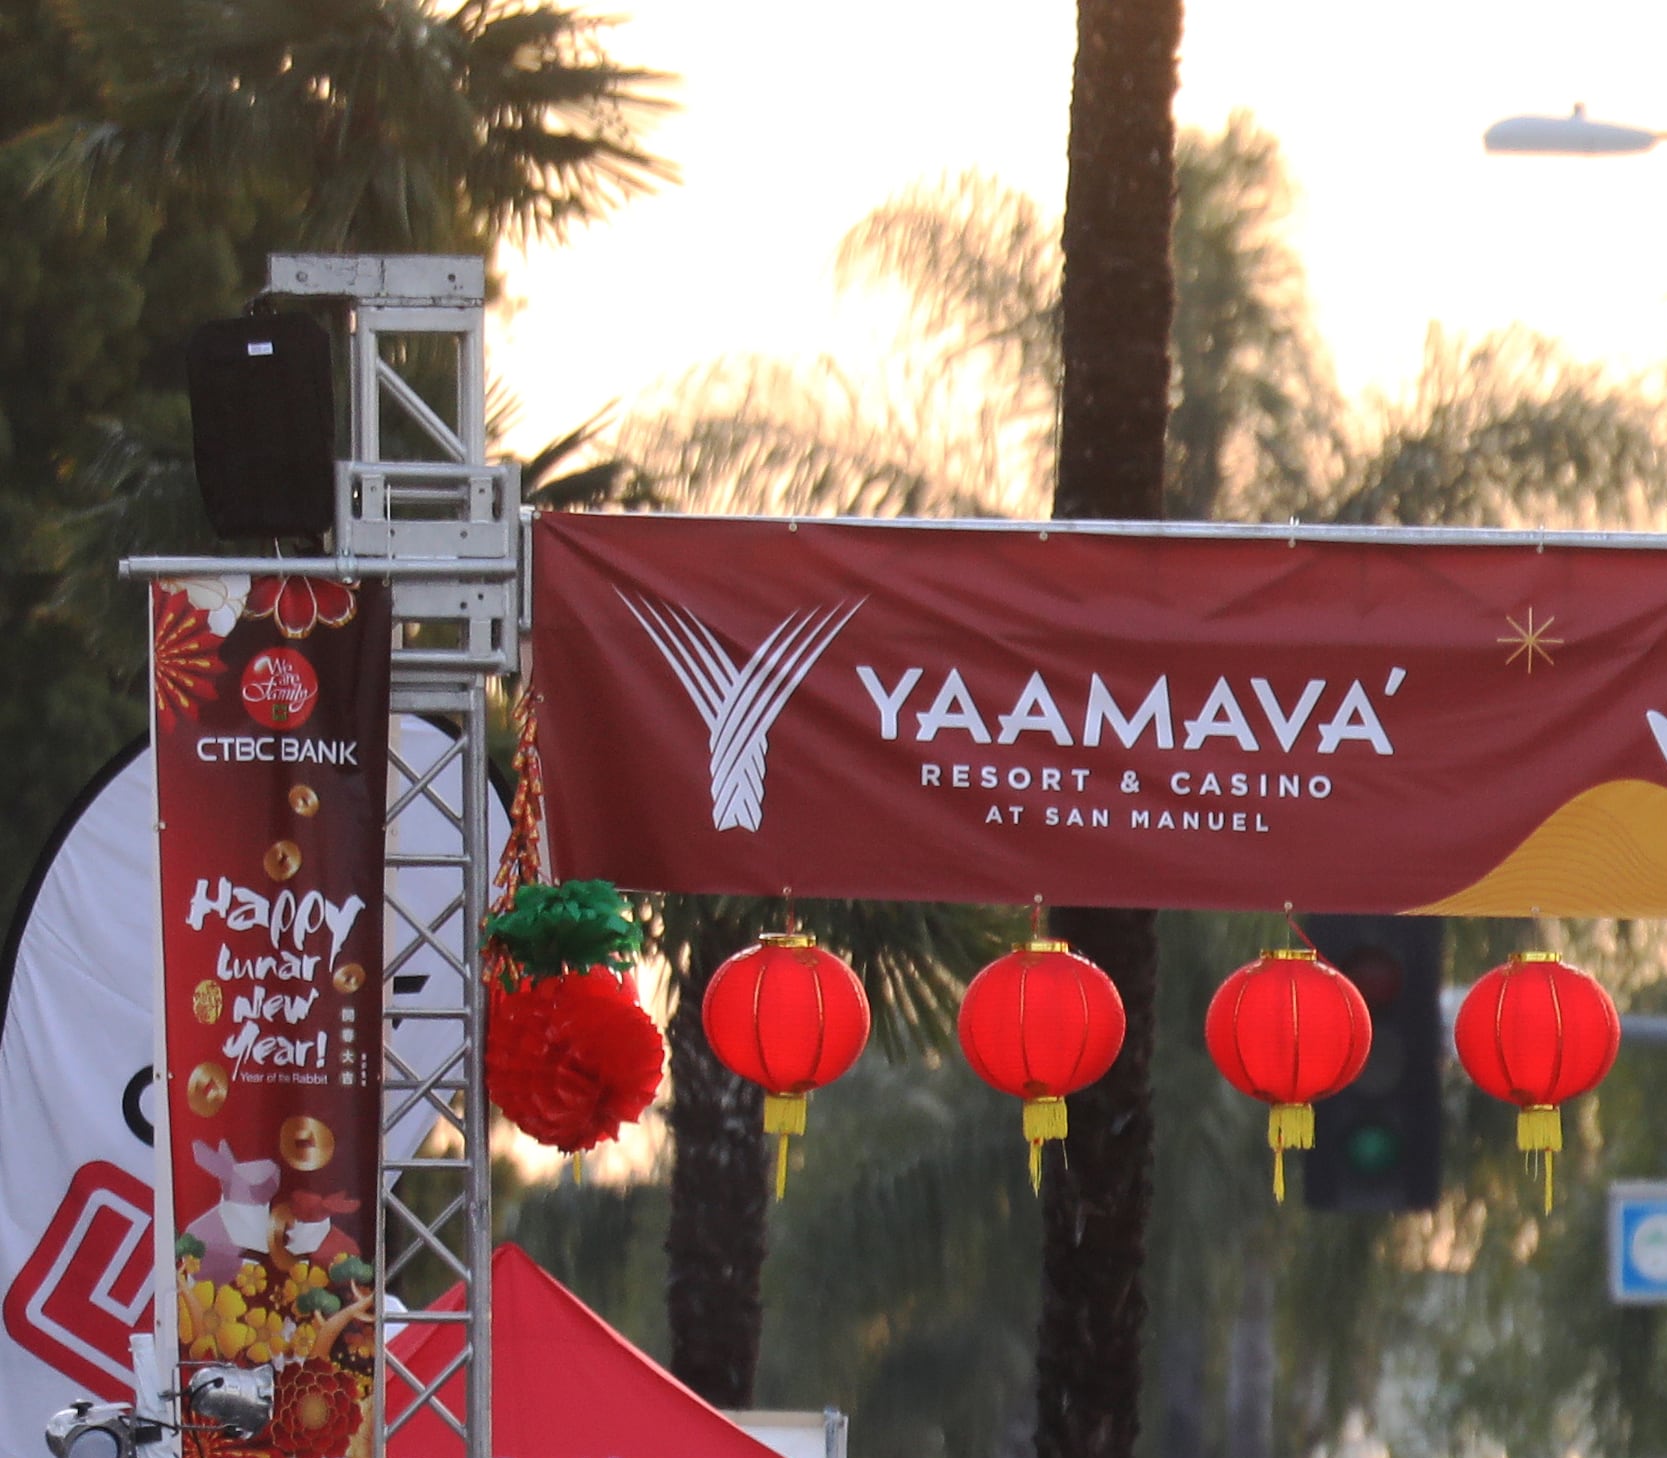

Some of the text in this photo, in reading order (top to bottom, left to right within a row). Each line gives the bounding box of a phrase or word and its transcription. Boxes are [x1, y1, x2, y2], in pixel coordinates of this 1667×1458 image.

[196, 736, 358, 766] CTBC BANK
[921, 763, 1332, 799] RESORT & CASINO
[985, 805, 1270, 833] AT SAN MANUEL
[186, 876, 366, 973] Happy
[233, 985, 320, 1024] New
